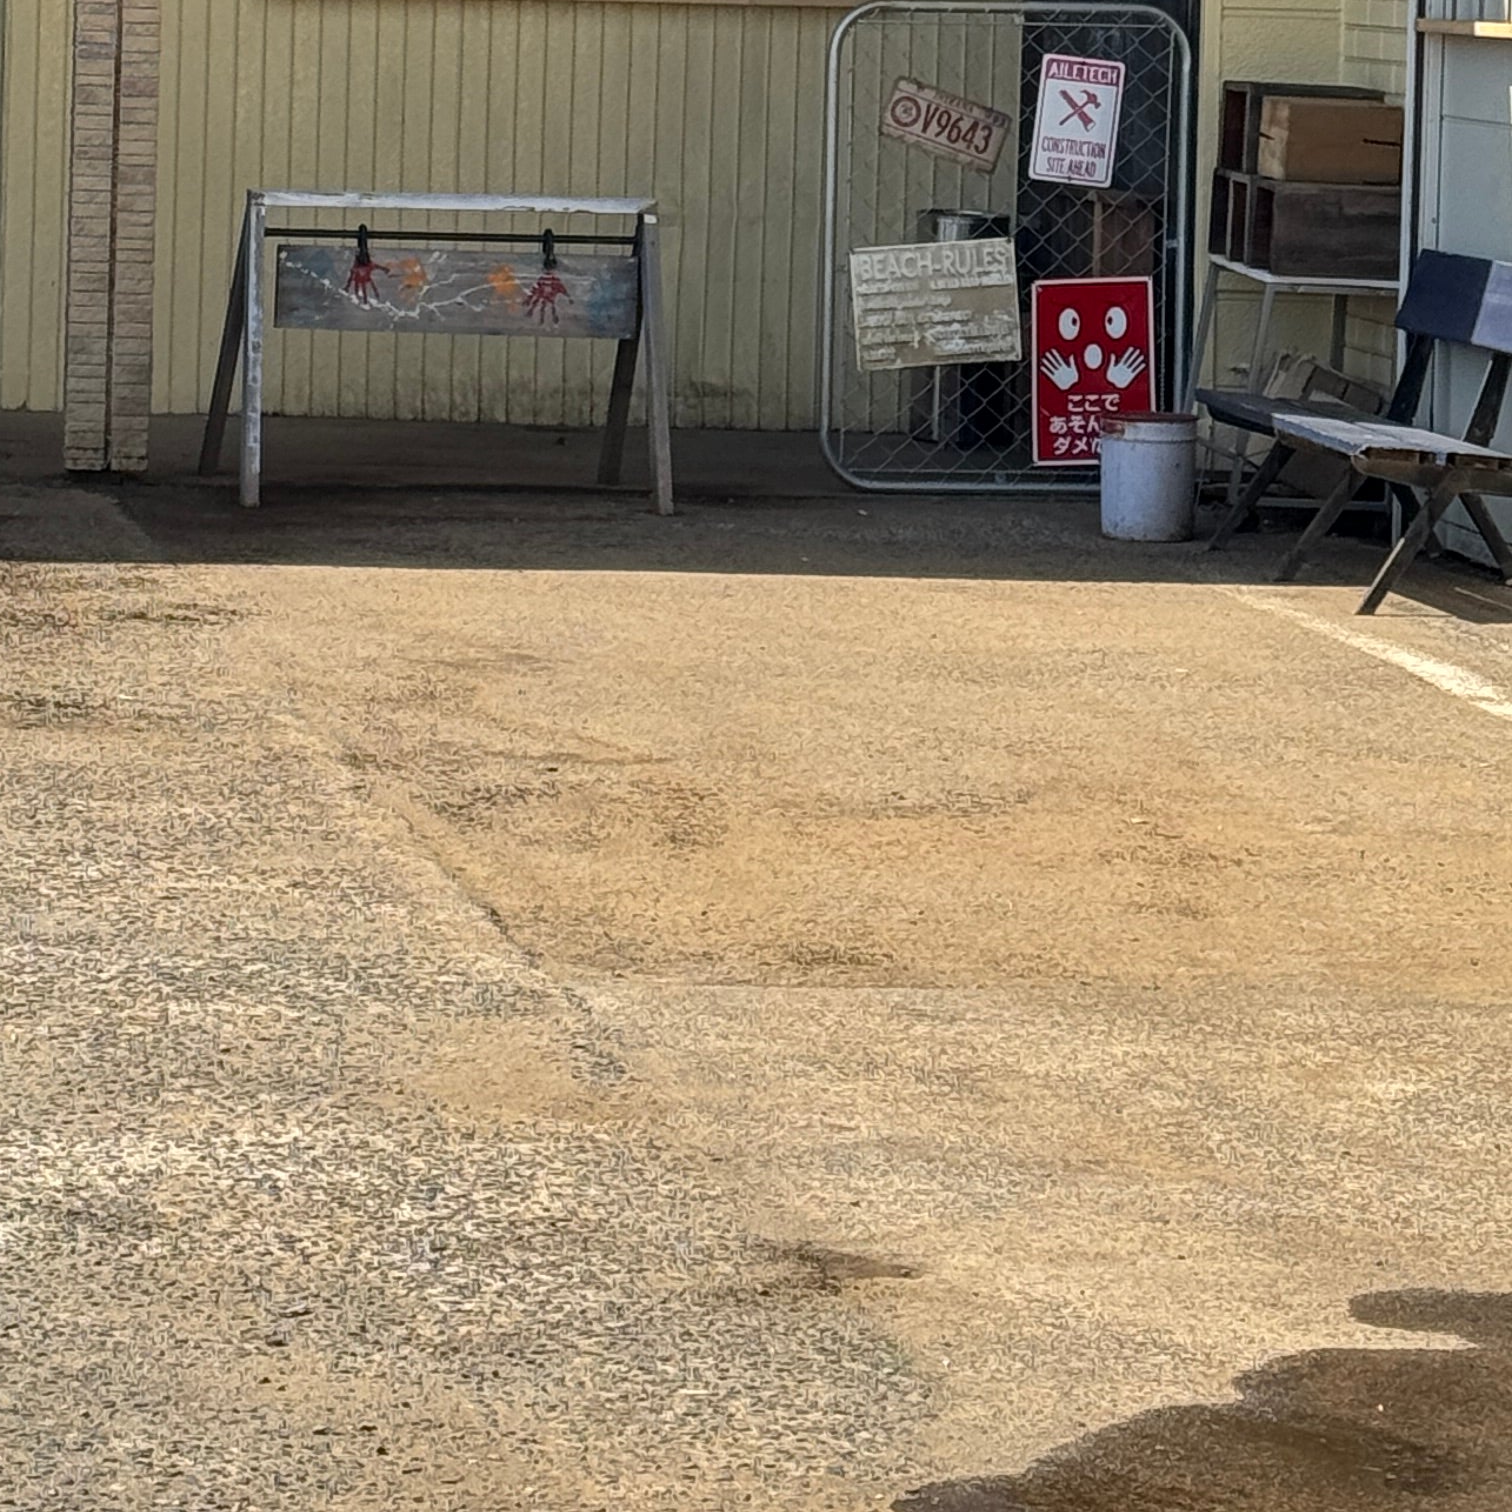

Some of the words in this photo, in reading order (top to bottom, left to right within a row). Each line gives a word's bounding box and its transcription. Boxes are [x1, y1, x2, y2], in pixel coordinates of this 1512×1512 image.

[921, 103, 993, 155] V9643
[1041, 136, 1107, 159] CONSTRUCTION
[1046, 157, 1066, 174] SITE
[1067, 393, 1120, 412] ここで
